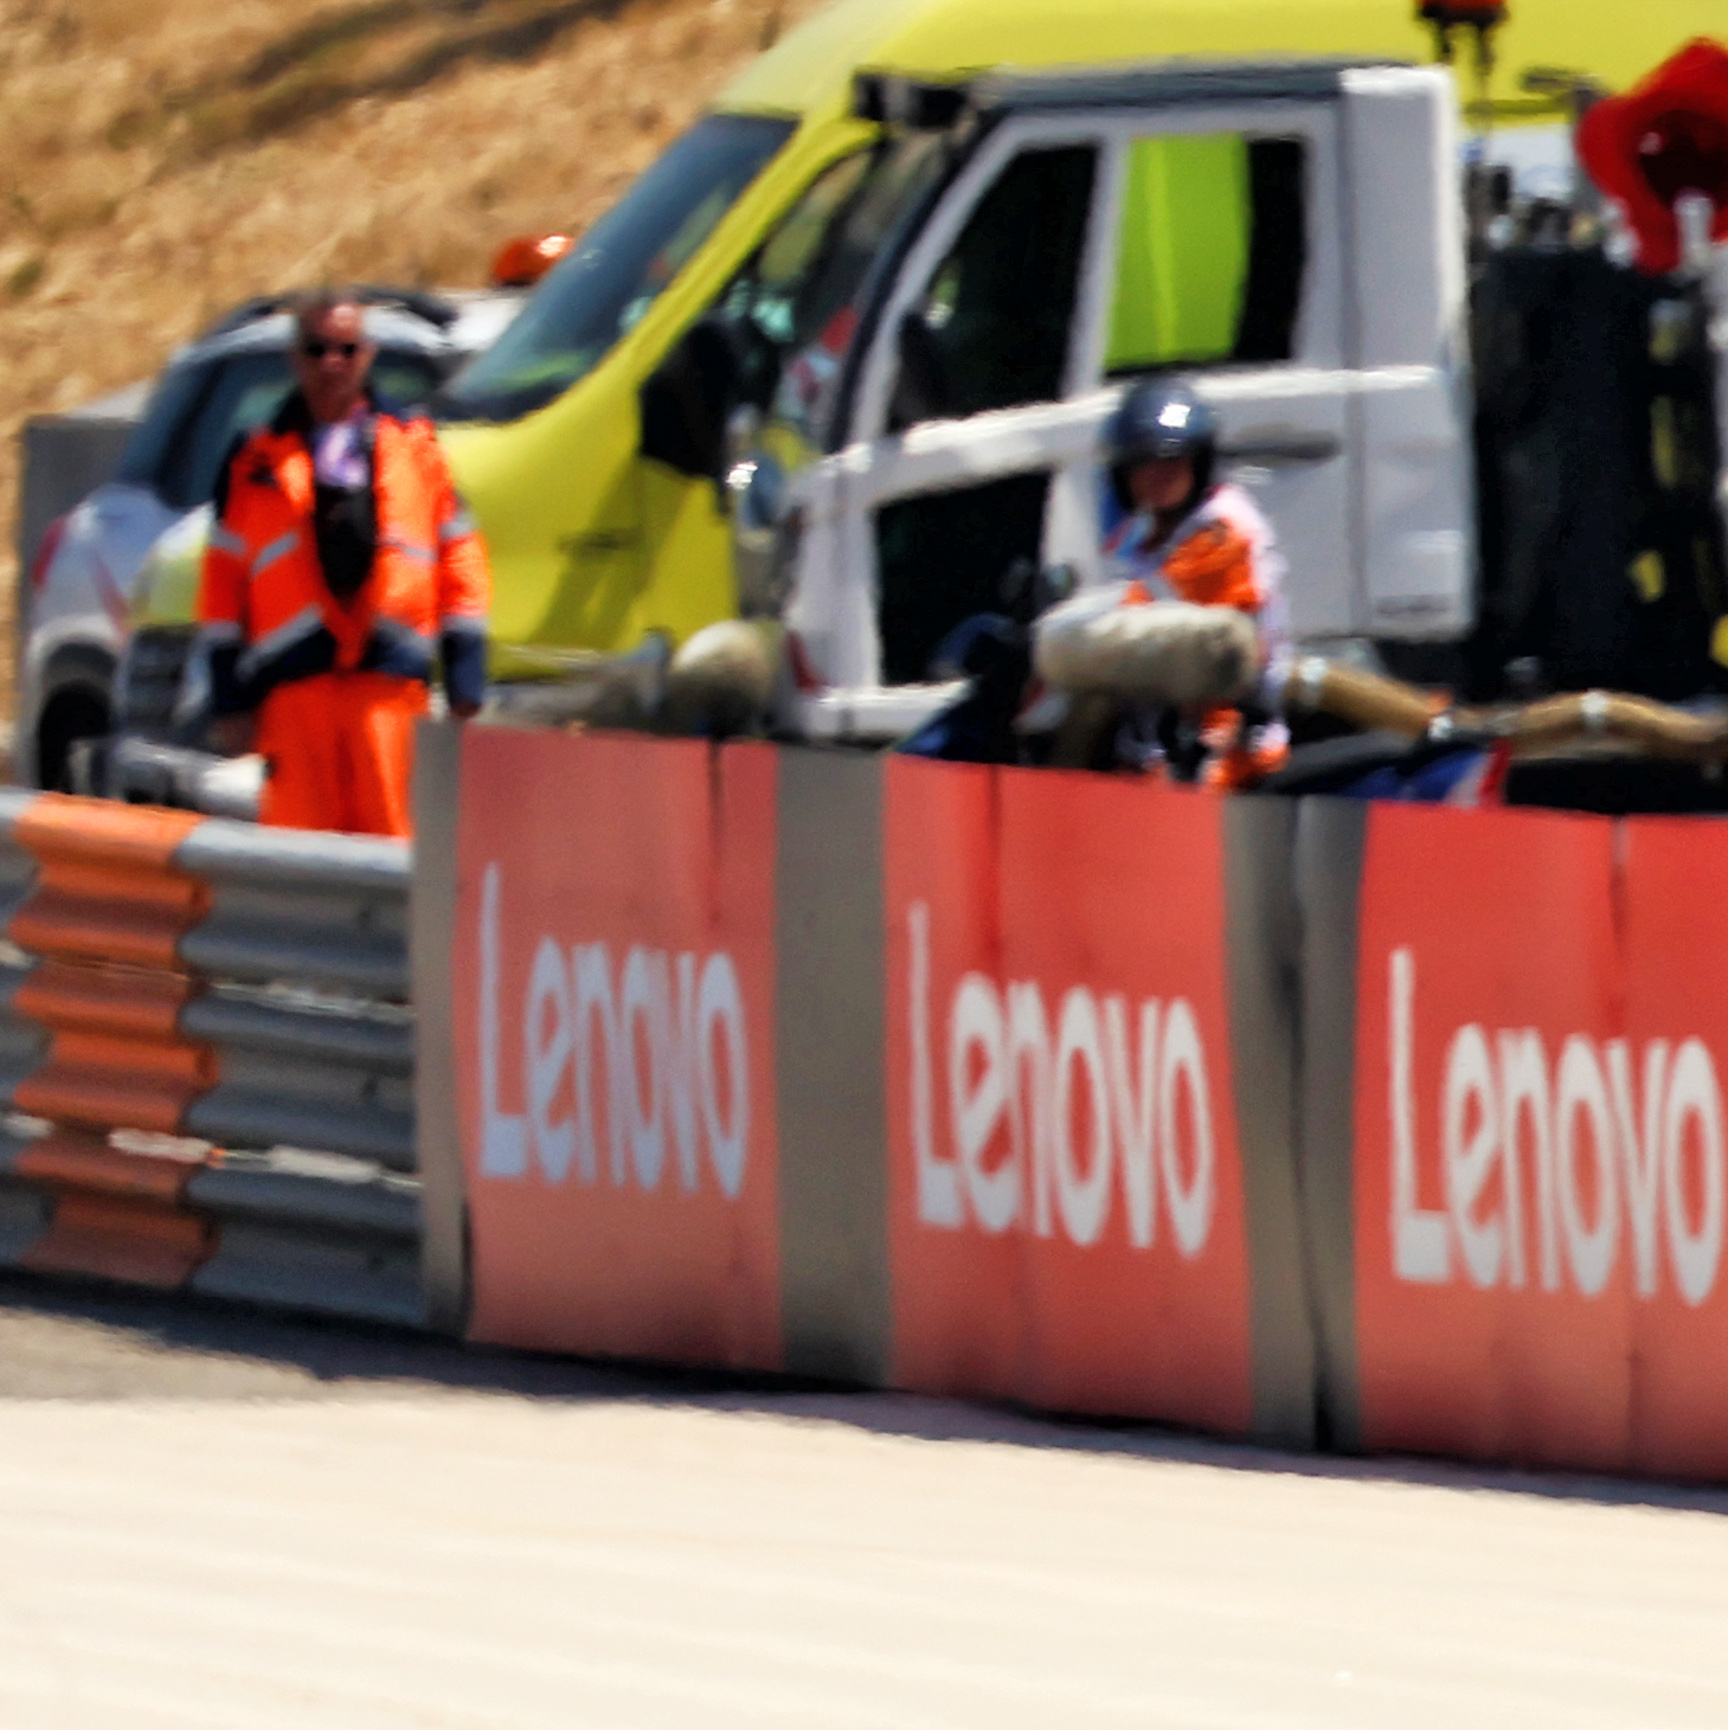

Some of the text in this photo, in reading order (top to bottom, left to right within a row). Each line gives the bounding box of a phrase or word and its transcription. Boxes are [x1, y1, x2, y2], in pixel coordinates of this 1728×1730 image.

[478, 861, 748, 1197] Lenovo
[908, 899, 1215, 1260] Lenovo
[1391, 949, 1726, 1307] Lenovo
